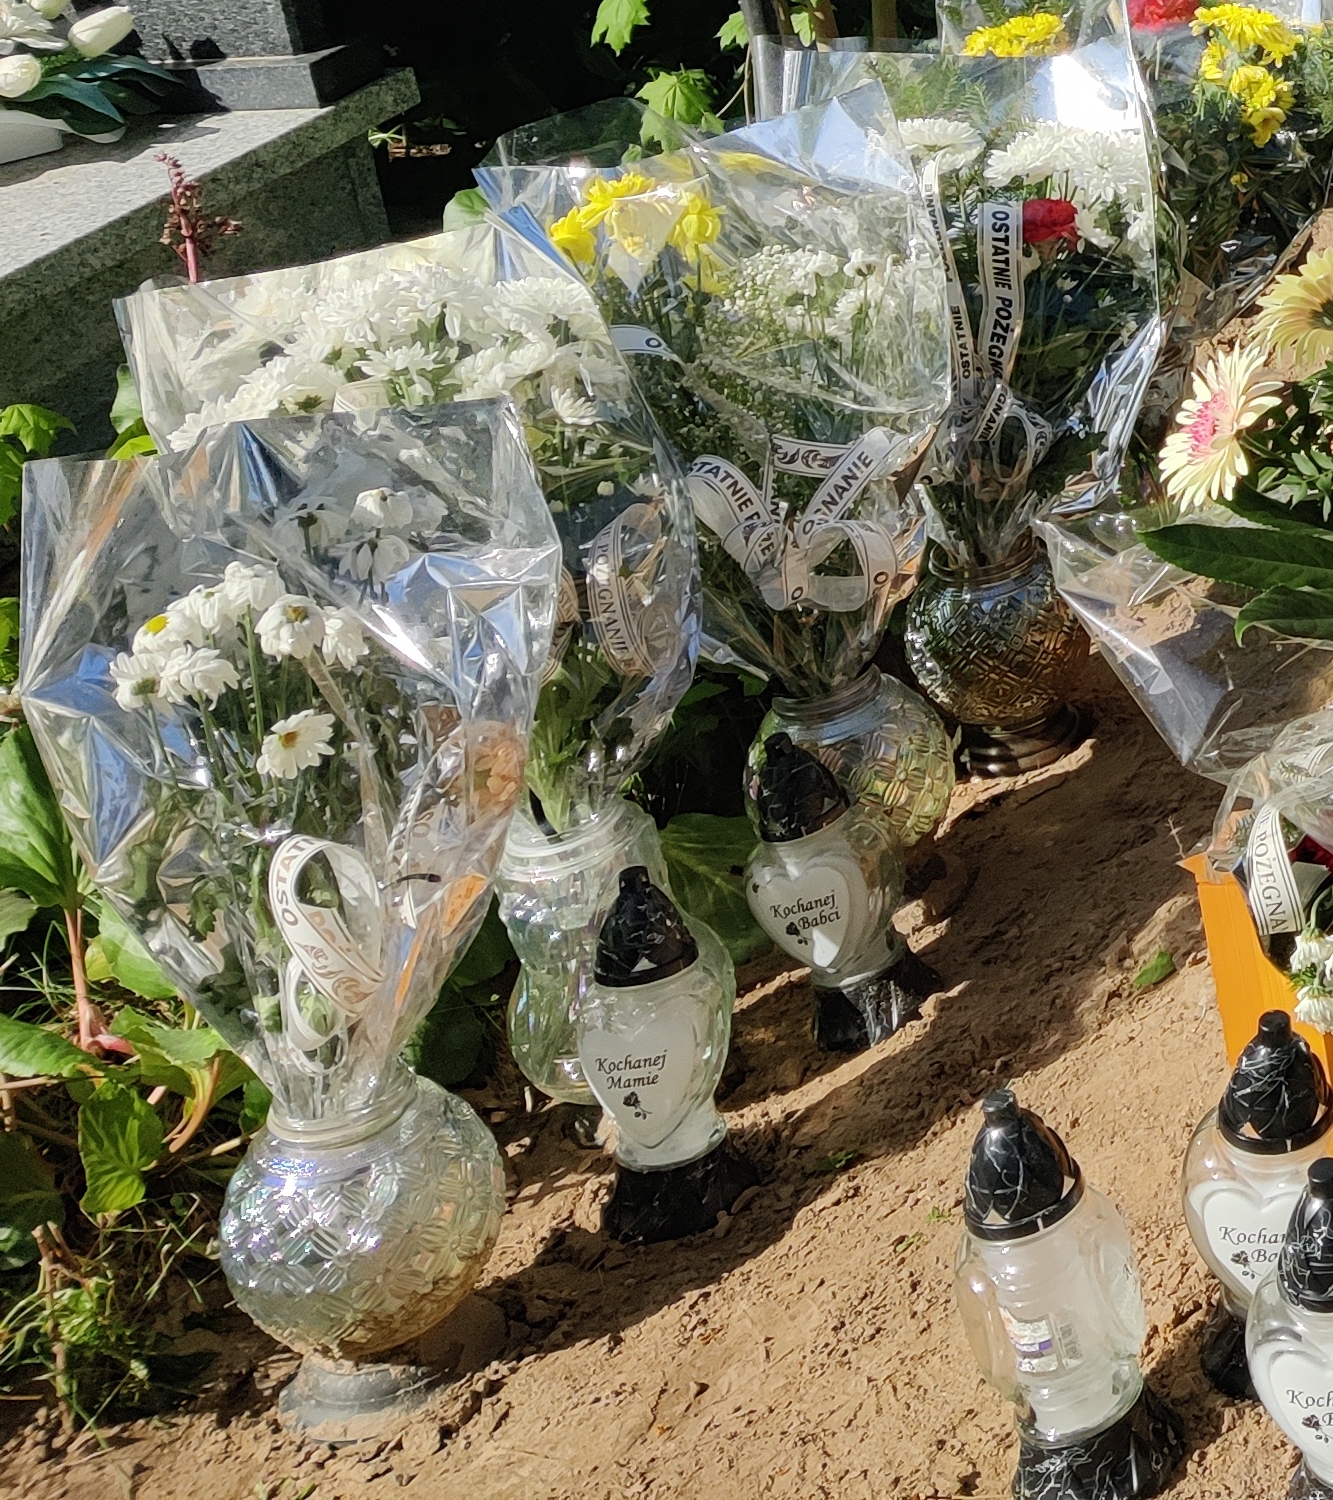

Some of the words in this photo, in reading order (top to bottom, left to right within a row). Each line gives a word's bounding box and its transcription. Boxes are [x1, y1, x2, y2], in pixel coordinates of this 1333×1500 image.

[991, 210, 1012, 291] OSTATNIE
[949, 304, 971, 380] OSTATNIE
[770, 890, 837, 919] Kochanej
[797, 906, 842, 931] Babci
[595, 1049, 668, 1073] Kochanej
[606, 1072, 660, 1090] Mamie
